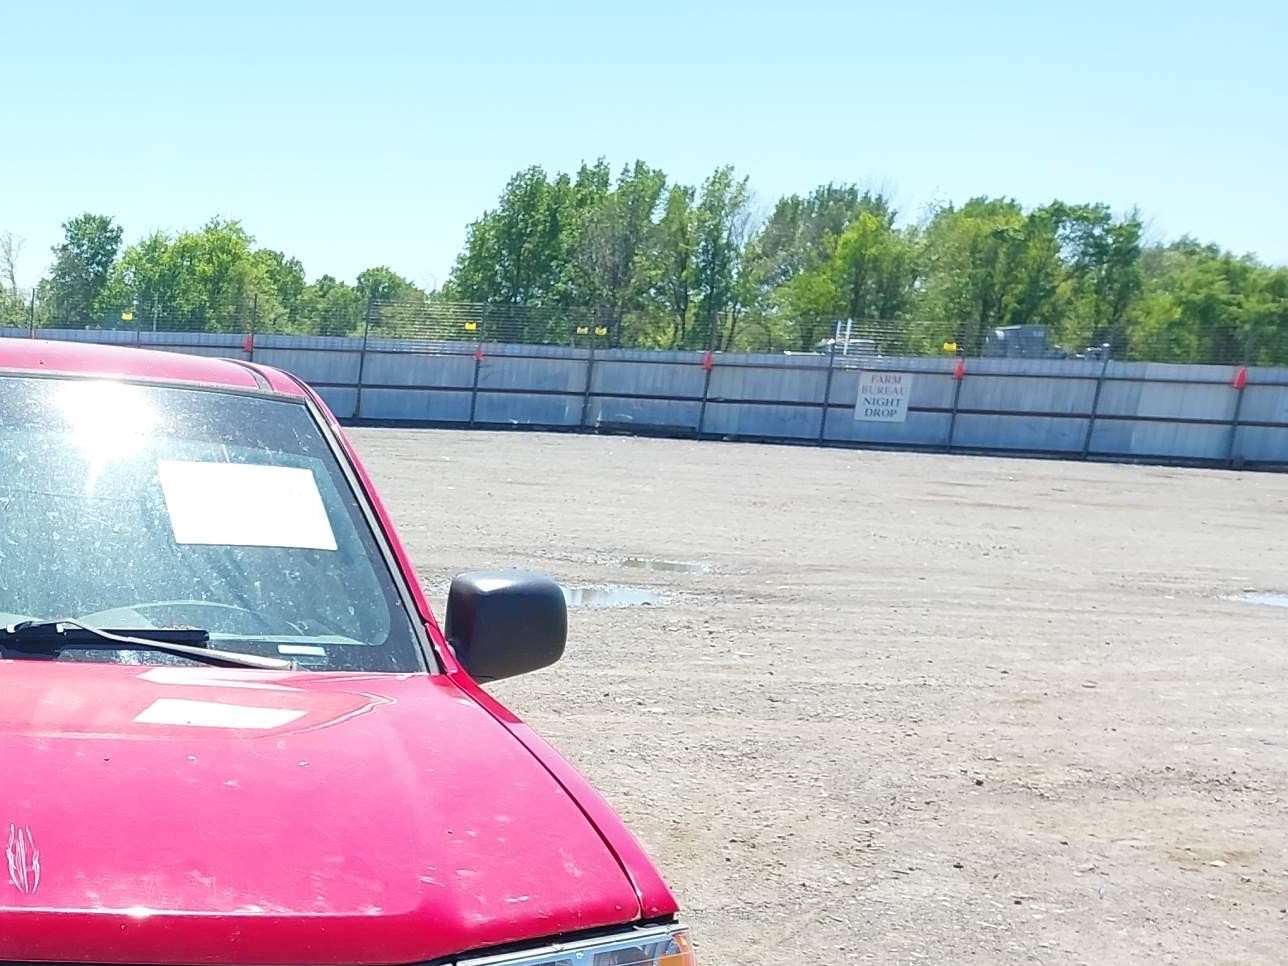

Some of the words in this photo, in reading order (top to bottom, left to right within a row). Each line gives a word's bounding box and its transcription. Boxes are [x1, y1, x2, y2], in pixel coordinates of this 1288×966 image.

[871, 375, 902, 385] FARM
[861, 385, 904, 396] BUREAU
[864, 397, 901, 408] NIGHT
[864, 408, 898, 417] DROP
